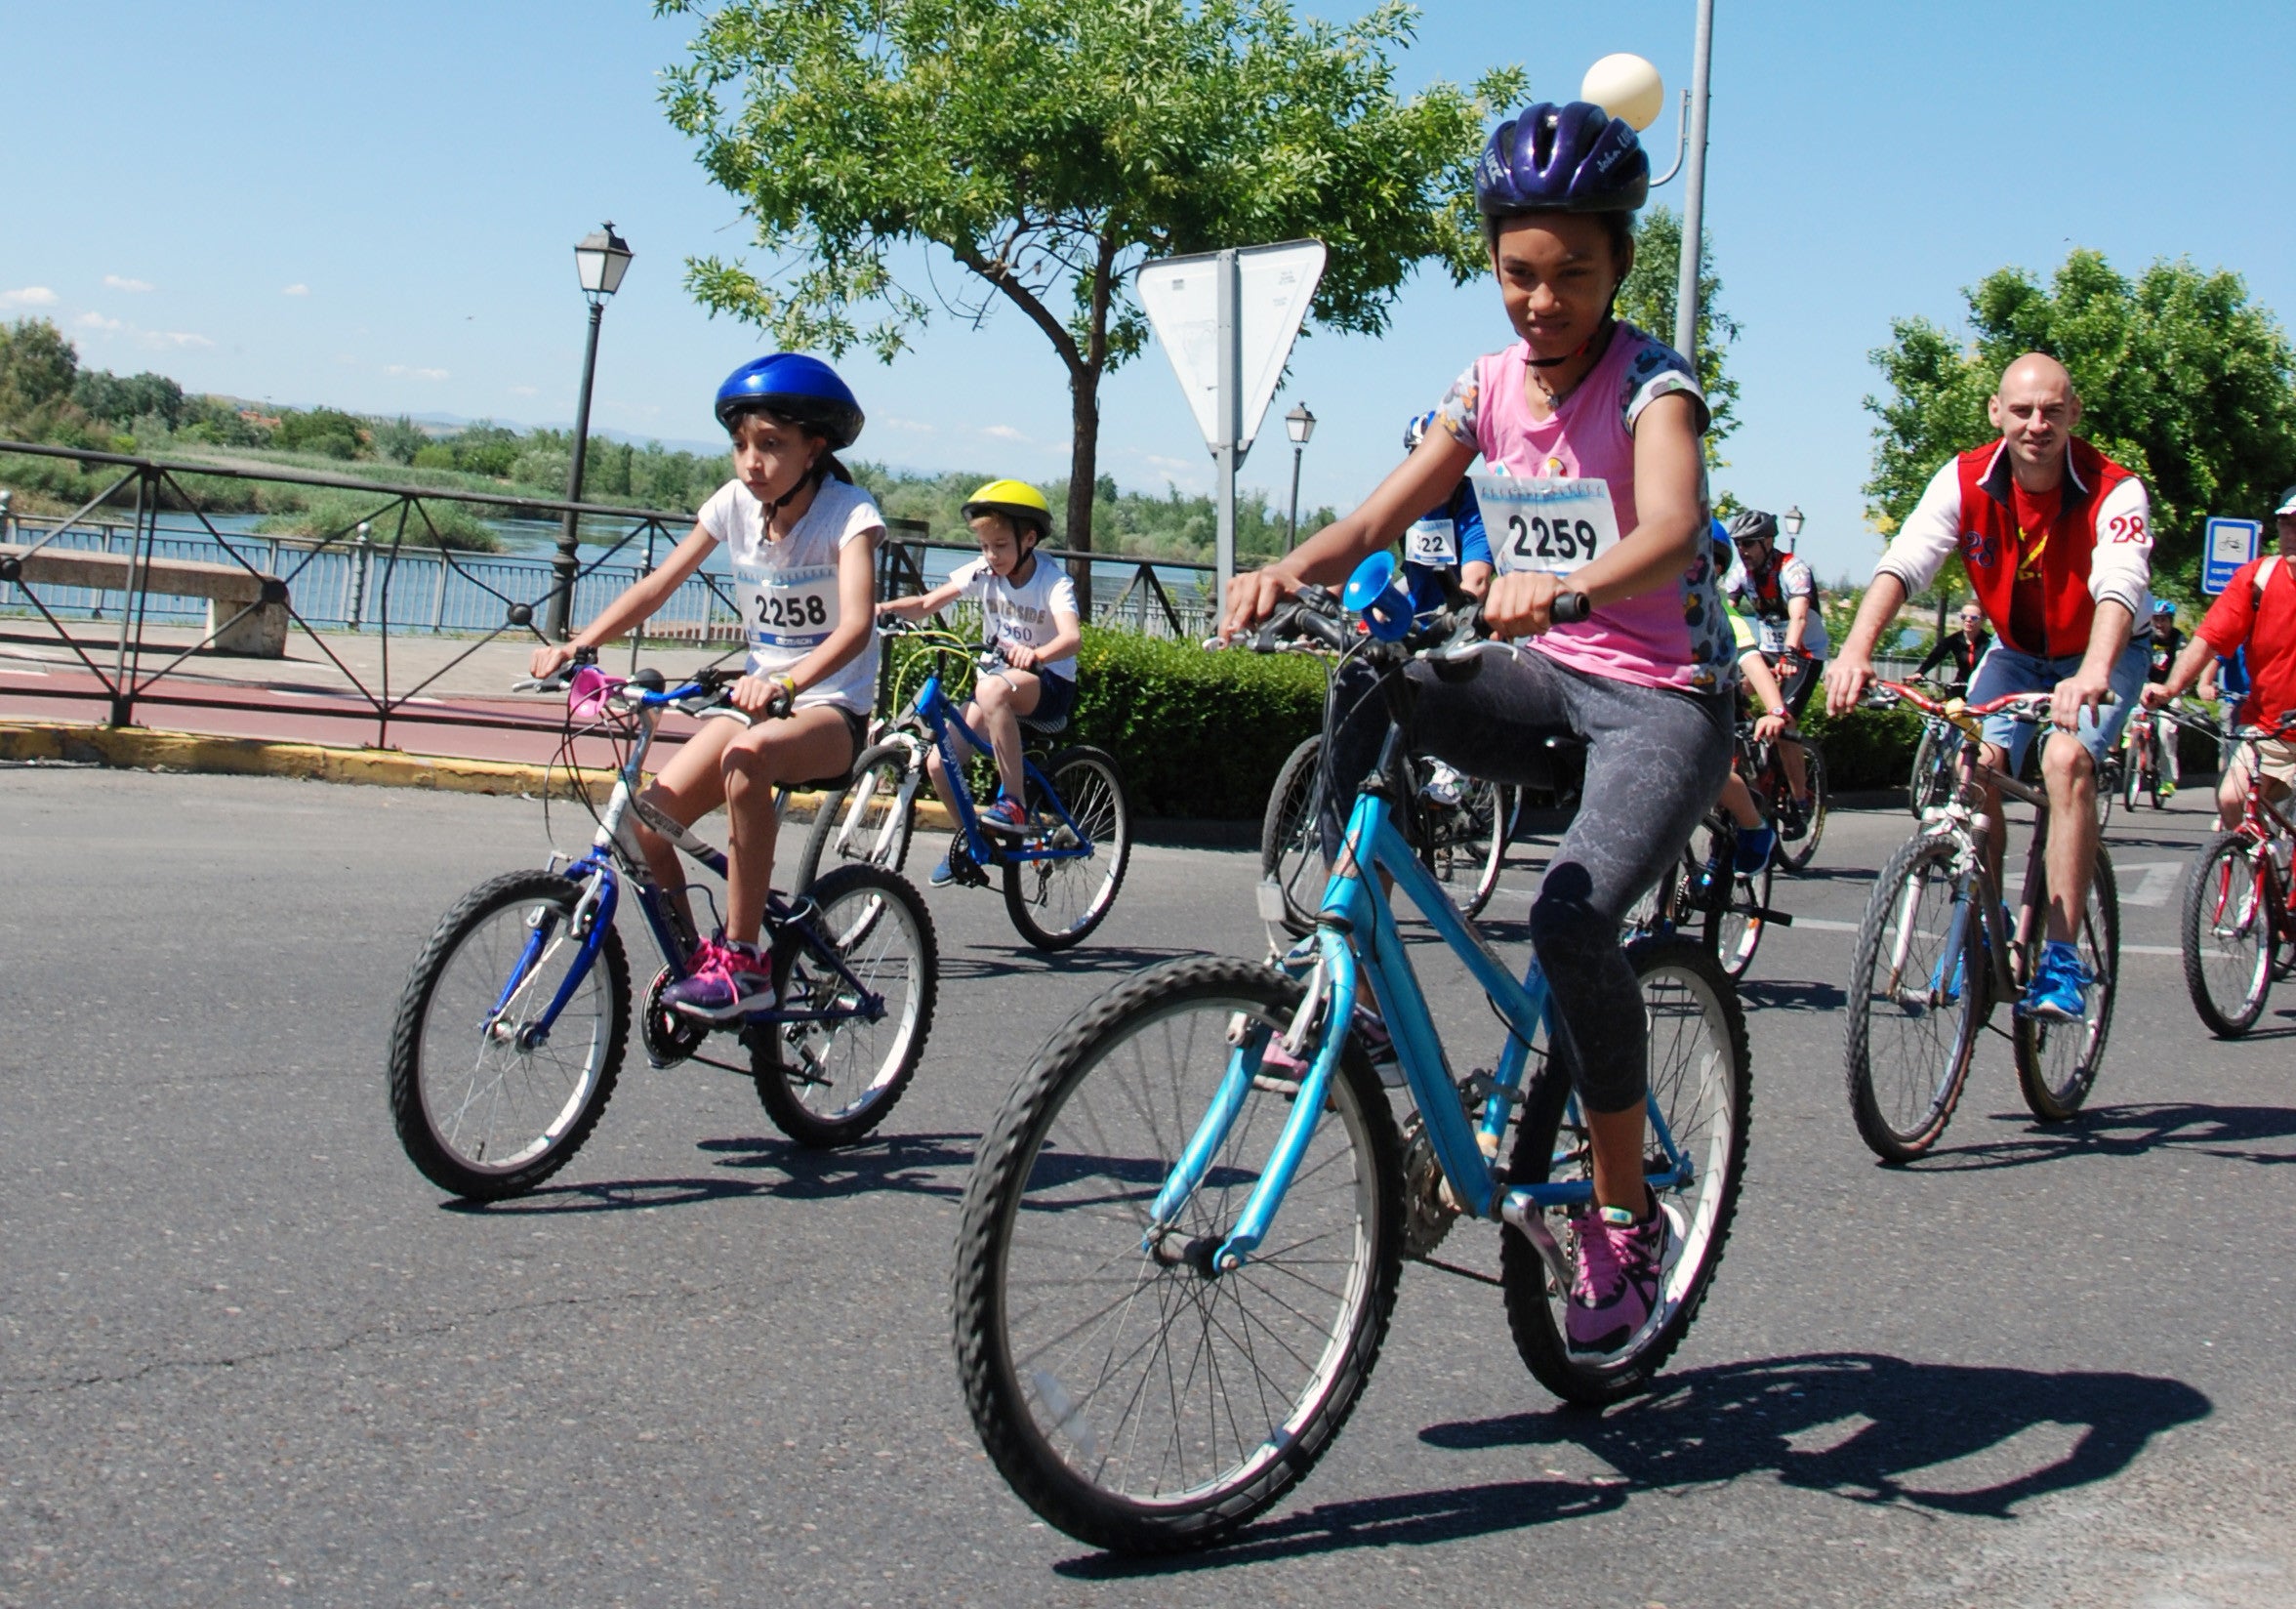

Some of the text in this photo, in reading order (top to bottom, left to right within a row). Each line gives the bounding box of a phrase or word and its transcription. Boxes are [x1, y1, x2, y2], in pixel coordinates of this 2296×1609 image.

[1509, 515, 1597, 560] 2259
[2109, 516, 2147, 544] 28
[1961, 530, 1996, 568] 28
[756, 595, 827, 627] 2258
[1766, 631, 1787, 643] 125
